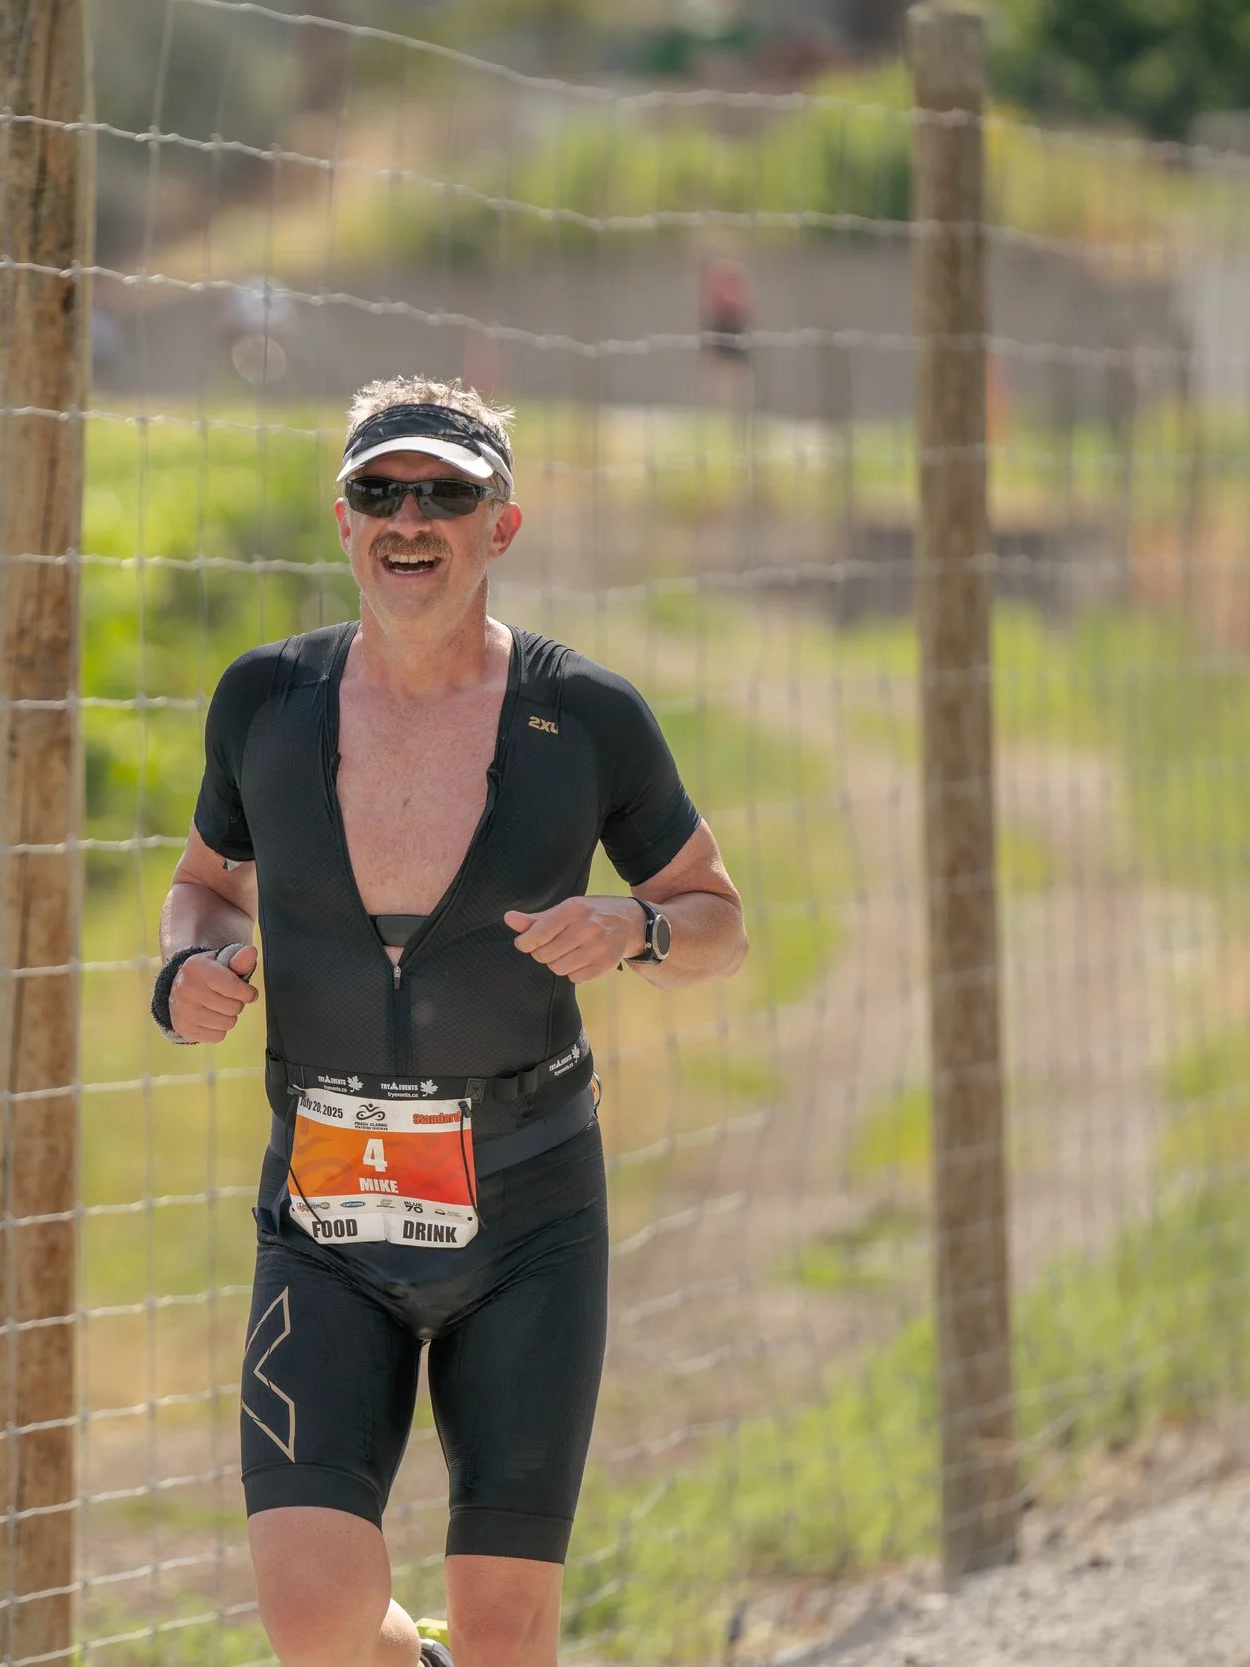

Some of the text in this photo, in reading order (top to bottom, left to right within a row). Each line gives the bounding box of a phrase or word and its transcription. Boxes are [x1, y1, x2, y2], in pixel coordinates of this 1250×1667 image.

[322, 1104, 344, 1119] 2025
[412, 1110, 461, 1125] Standard
[363, 1138, 388, 1173] 4
[358, 1177, 399, 1194] MIKE
[404, 1204, 424, 1214] 70
[311, 1218, 457, 1244] FOOD DRINK
